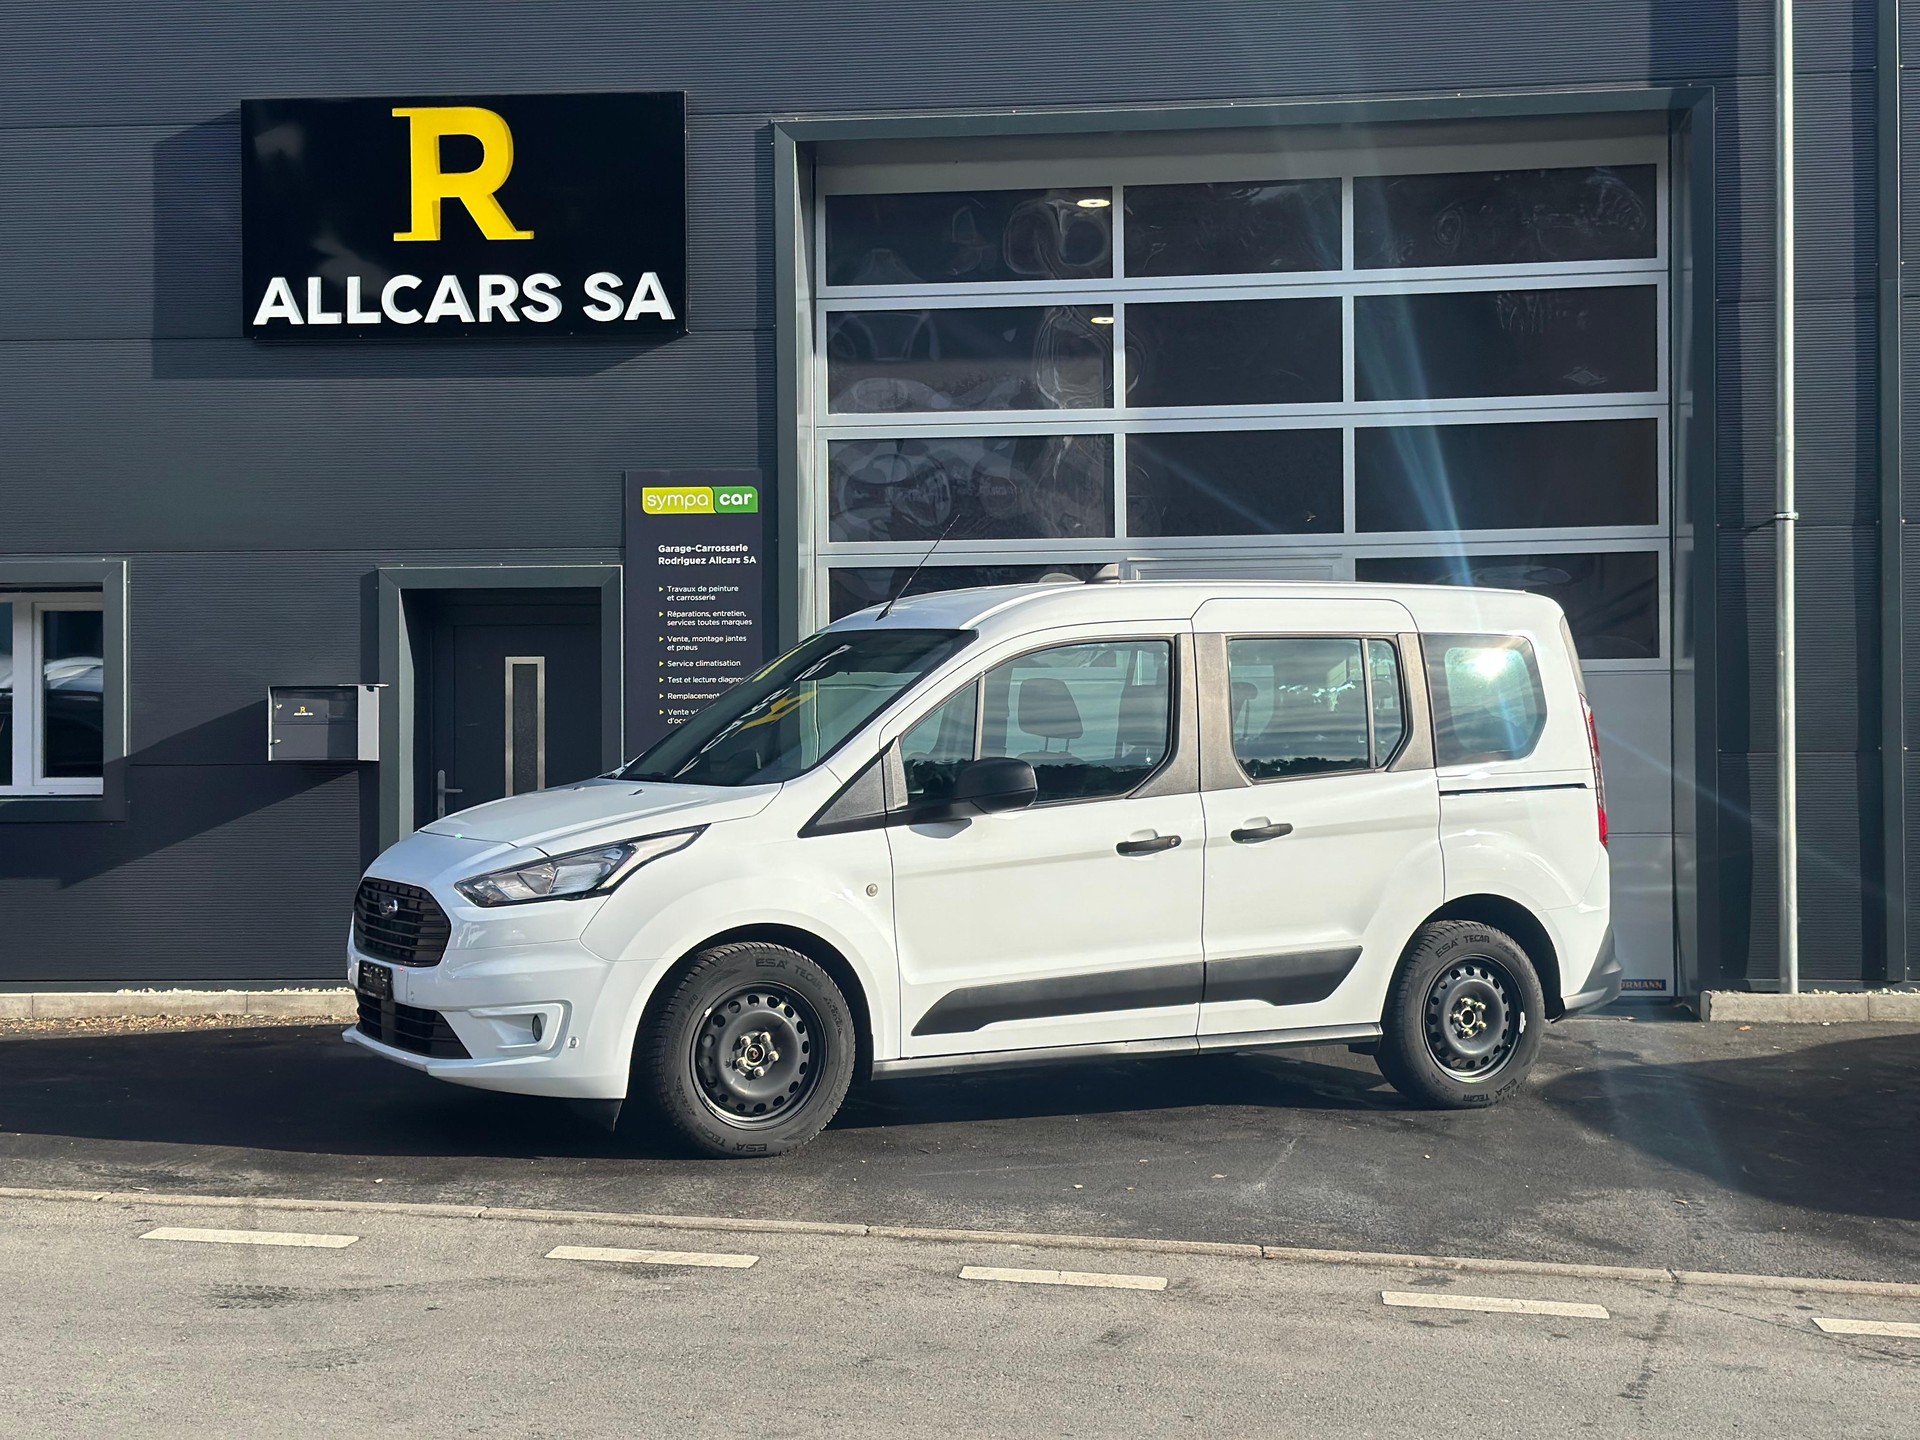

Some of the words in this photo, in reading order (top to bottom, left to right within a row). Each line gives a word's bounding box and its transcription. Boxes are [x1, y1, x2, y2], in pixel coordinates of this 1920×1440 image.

[391, 106, 535, 242] R
[253, 272, 563, 325] ALLCARS
[582, 271, 676, 322] SA
[647, 494, 709, 510] sympa
[719, 493, 752, 505] car
[658, 544, 748, 554] Garage-Carrosserie
[658, 556, 706, 566] Rodriguez
[708, 556, 741, 564] Allcars
[743, 556, 757, 564] SA
[708, 585, 739, 593] peinture
[667, 610, 711, 618] Réparations,
[667, 635, 690, 643] Vente,
[691, 635, 724, 643] montage
[695, 659, 741, 667] climatisation
[667, 708, 690, 716] Vente
